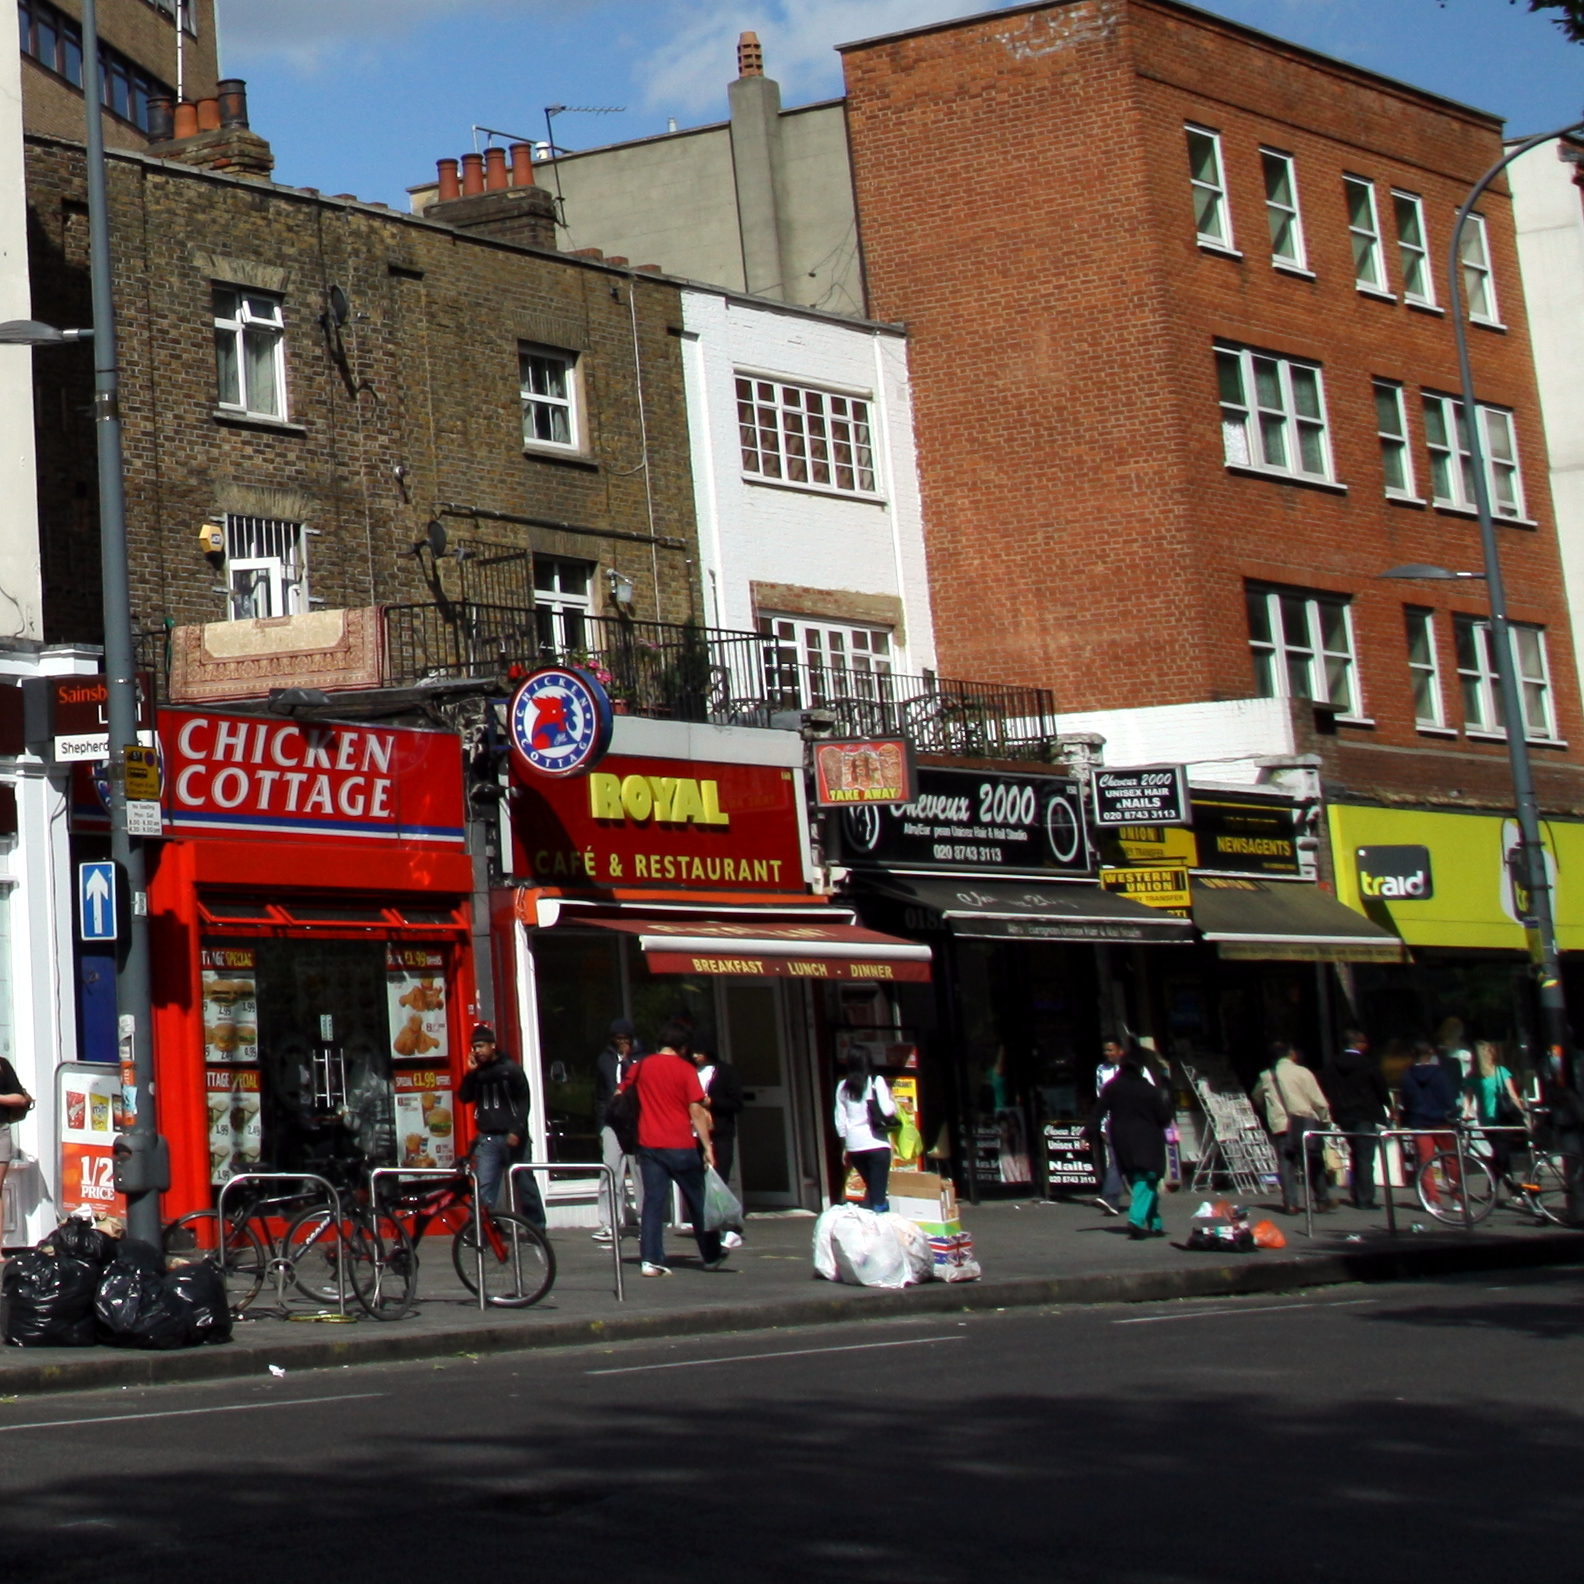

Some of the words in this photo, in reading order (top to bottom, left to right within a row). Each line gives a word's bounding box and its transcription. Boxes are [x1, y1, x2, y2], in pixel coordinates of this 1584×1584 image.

[58, 686, 108, 705] Sainsb
[516, 676, 589, 718] CHICKEN
[178, 717, 395, 775] CHICKEN
[520, 726, 592, 768] COTTAGE
[1141, 772, 1172, 786] 2000
[176, 763, 394, 818] COTTAGE
[589, 772, 730, 826] ROYAL
[829, 789, 858, 801] TAKE
[863, 787, 898, 801] AWAY
[1105, 788, 1143, 797] UNISEX
[1144, 787, 1170, 796] HAIR
[979, 782, 1035, 825] 2000
[1122, 797, 1162, 808] NAILS
[1103, 810, 1122, 820] 020
[1150, 809, 1176, 819] 3113
[933, 844, 952, 859] 020
[954, 845, 978, 860] 8743
[979, 847, 1002, 862] 3113
[1216, 836, 1292, 856] NEWSAGENTS
[535, 844, 596, 877] CAFÉ
[608, 854, 624, 878] &
[635, 854, 783, 884] RESTAURANT
[1104, 871, 1172, 884] WESTERN
[1126, 881, 1172, 892] UNION
[1360, 870, 1425, 896] traid
[692, 958, 764, 974] BREAKFAST
[787, 961, 827, 976] LUNCH
[850, 964, 894, 979] DINNER
[206, 1072, 231, 1088] TTAGE
[79, 1155, 115, 1187] 1/2
[1048, 1160, 1094, 1172] Nails
[80, 1186, 115, 1201] PRICE
